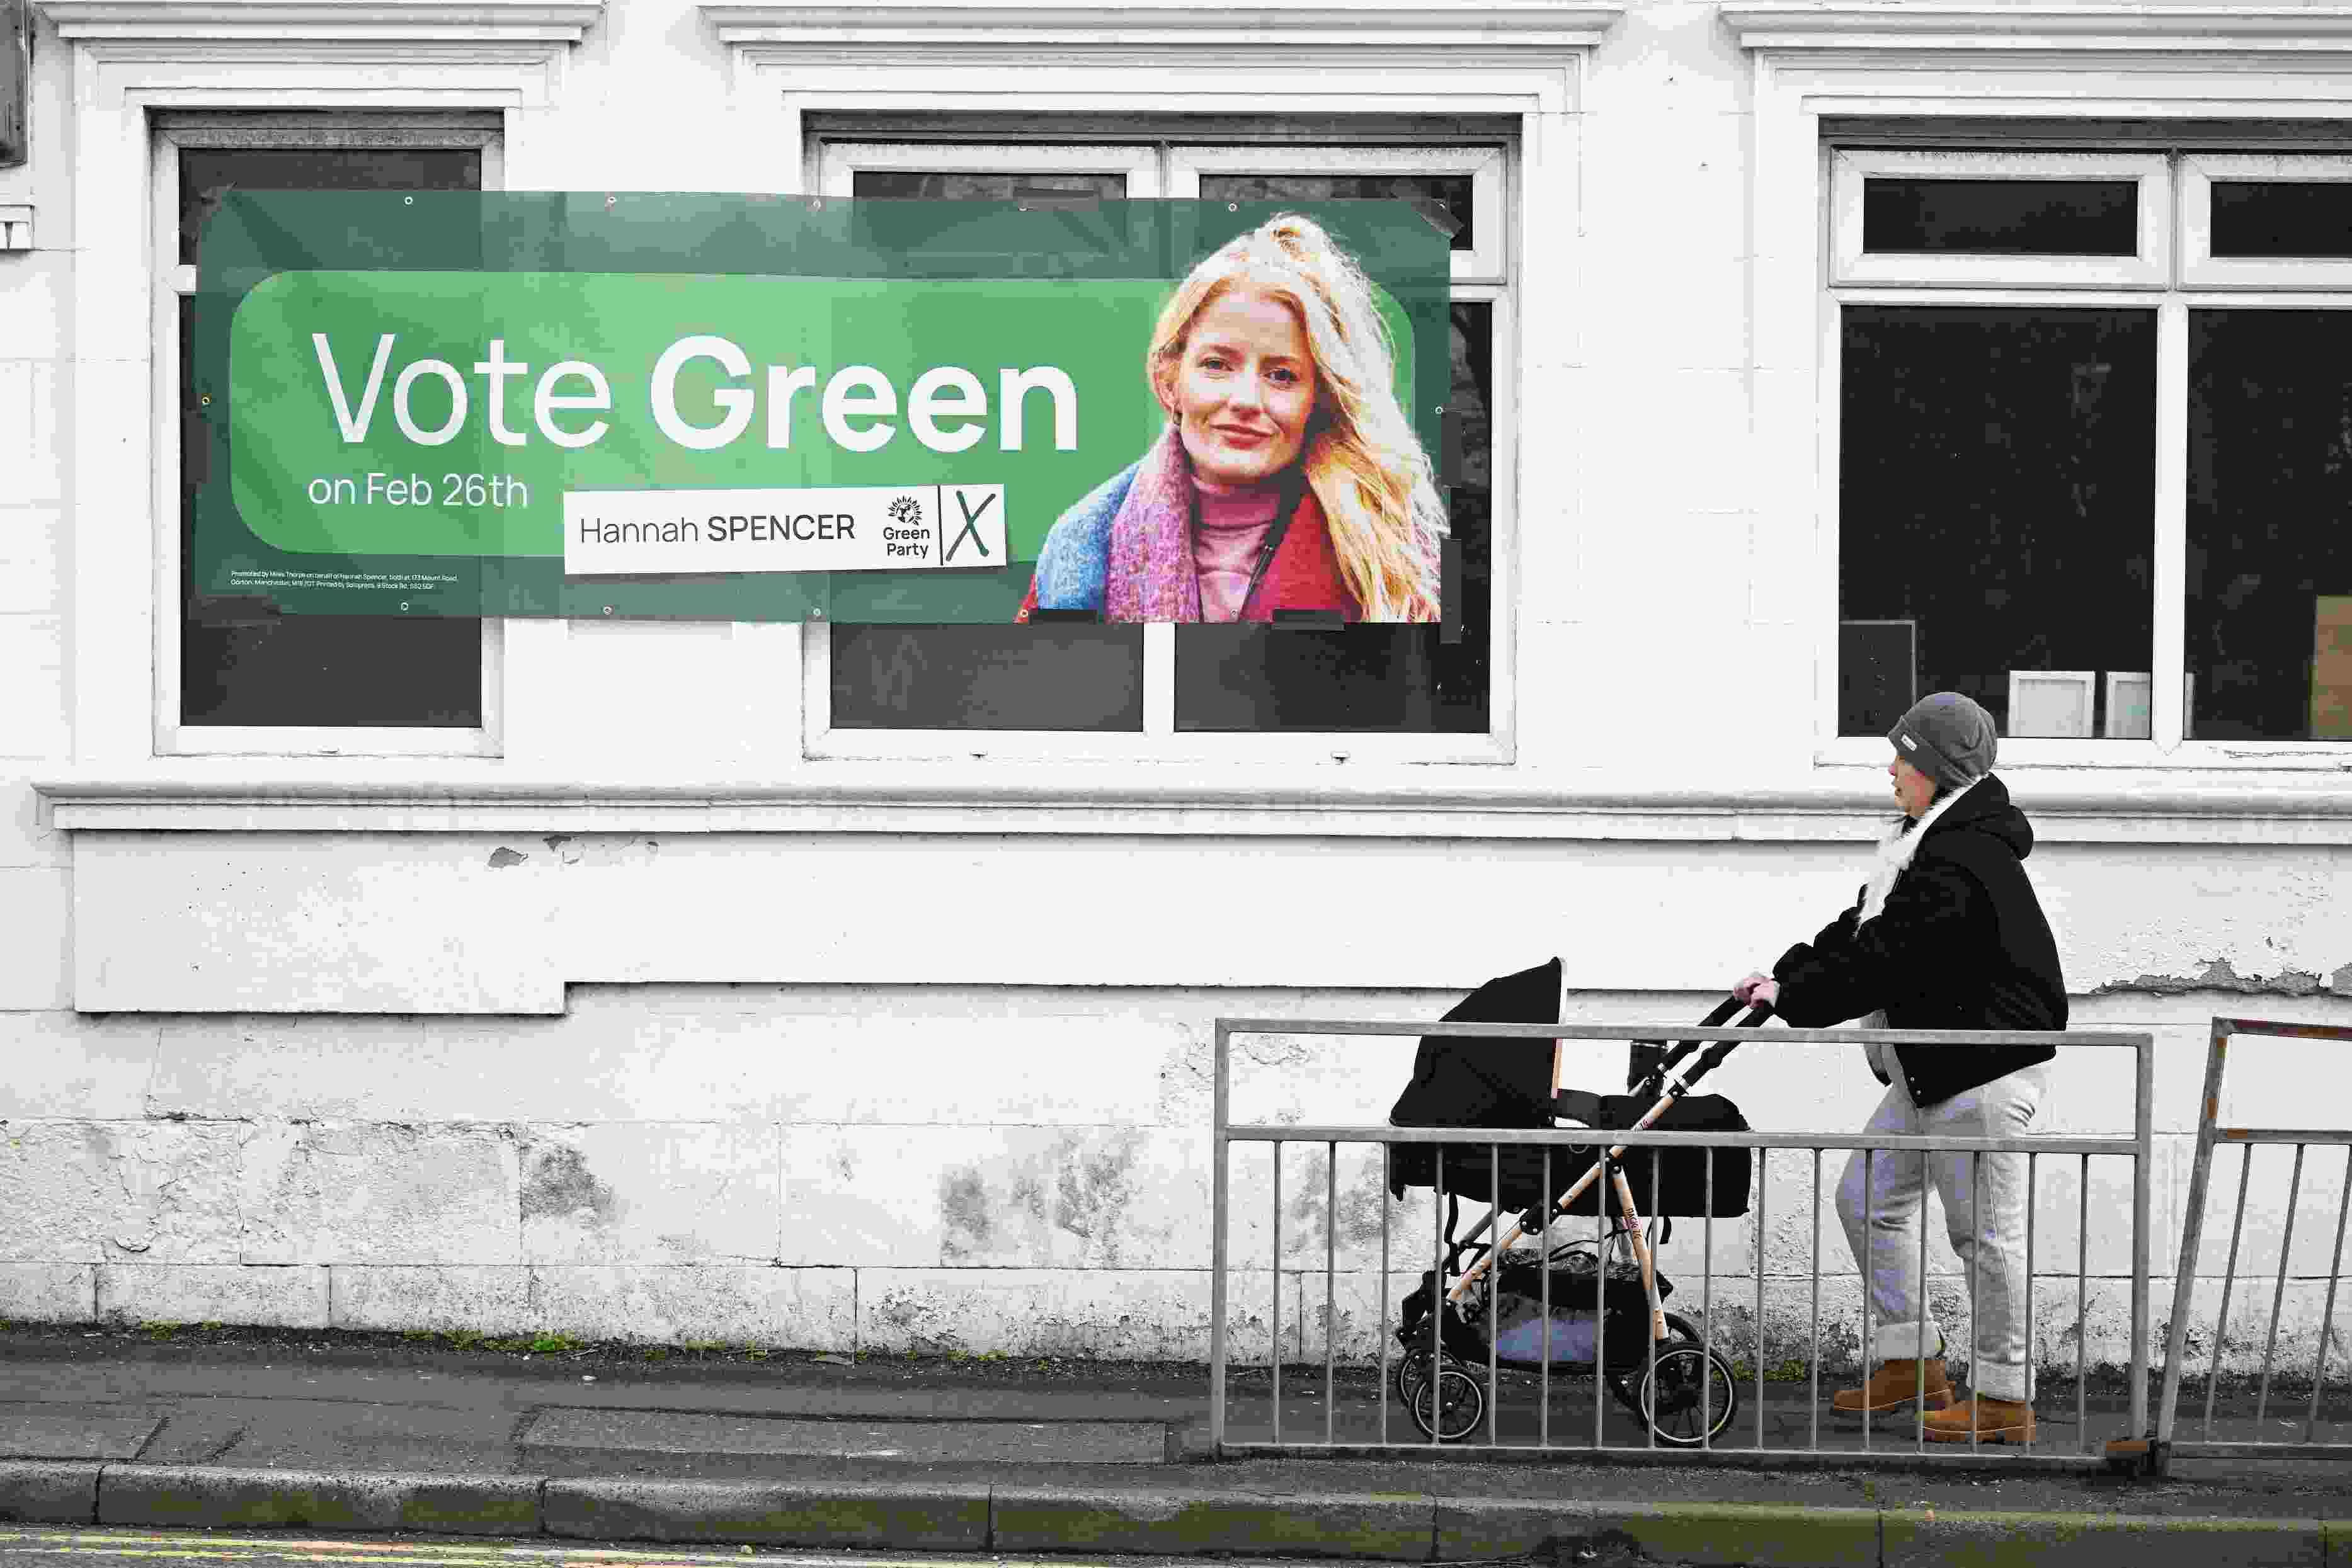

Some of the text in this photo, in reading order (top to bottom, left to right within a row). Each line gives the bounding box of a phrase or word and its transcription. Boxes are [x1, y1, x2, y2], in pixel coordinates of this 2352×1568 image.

[312, 334, 1076, 452] Vote Green
[309, 473, 527, 506] on Feb 26th
[581, 514, 855, 543] Hannah SPENCER
[883, 527, 930, 540] Green
[888, 543, 928, 559] Party
